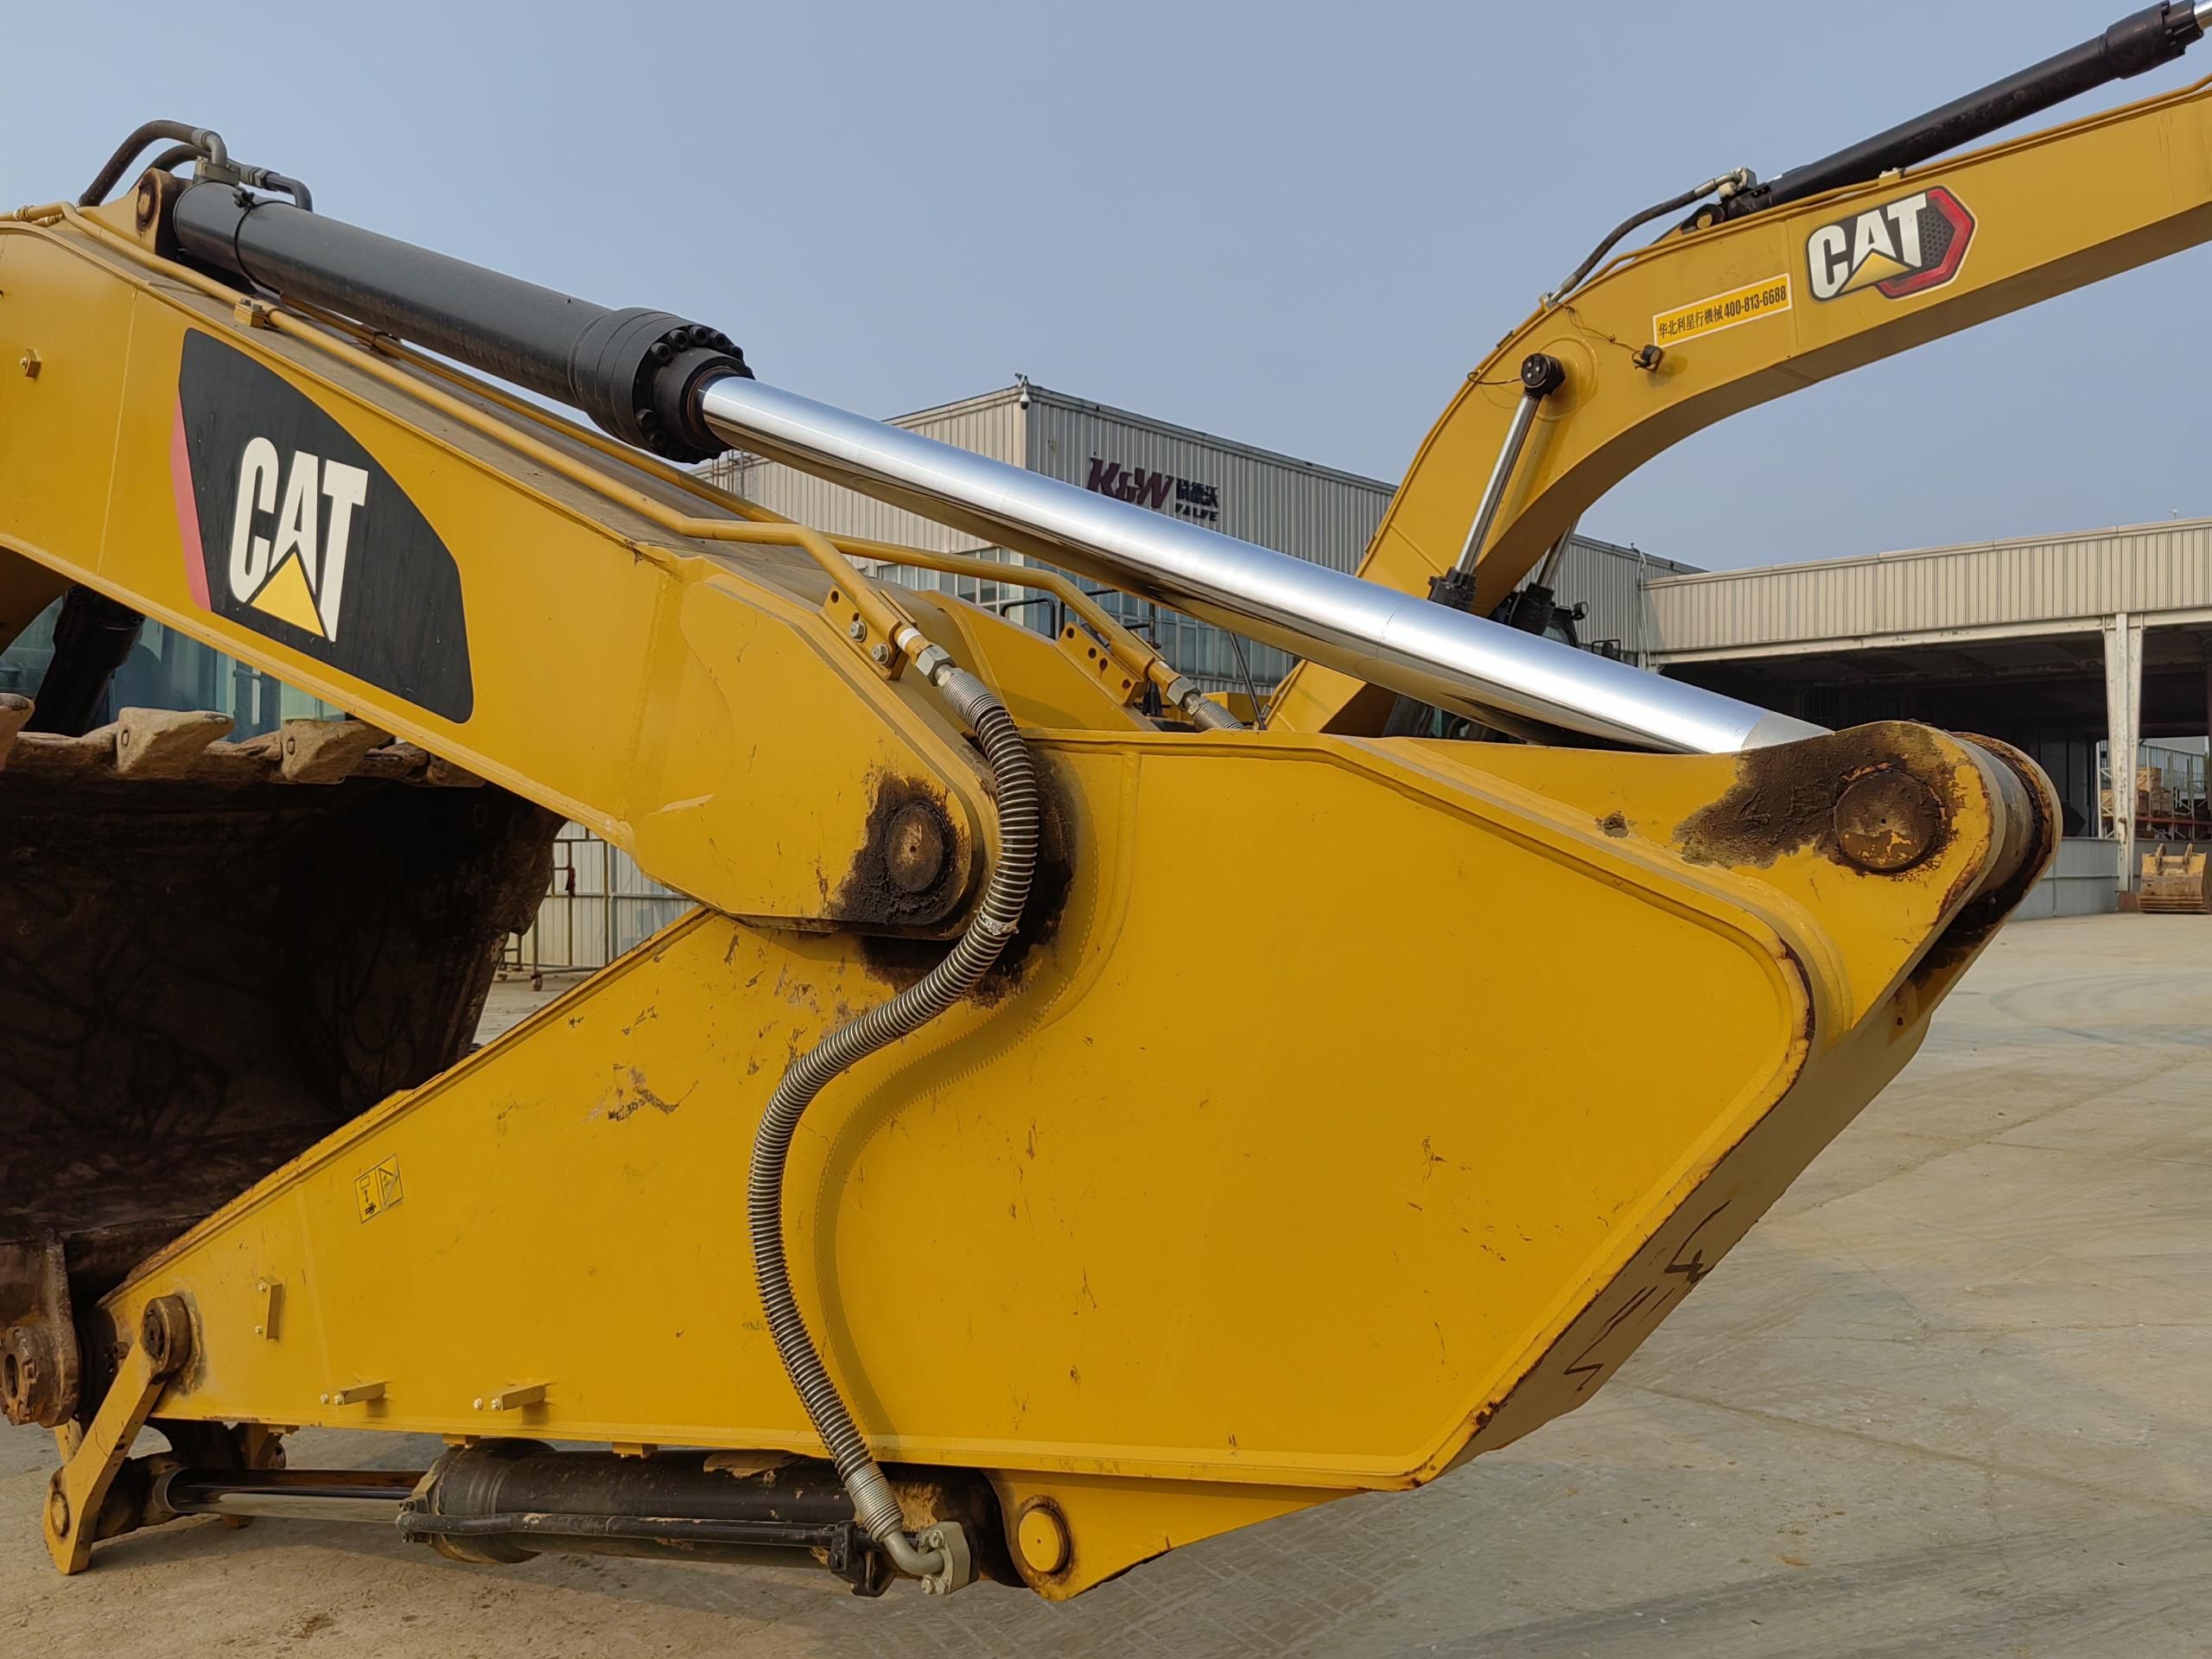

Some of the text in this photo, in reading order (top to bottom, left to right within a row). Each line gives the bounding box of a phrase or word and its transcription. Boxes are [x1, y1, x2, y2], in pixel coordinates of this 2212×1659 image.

[1808, 193, 1927, 298] CAT
[1724, 284, 1787, 318] 400-813-6688
[229, 436, 369, 643] CAT
